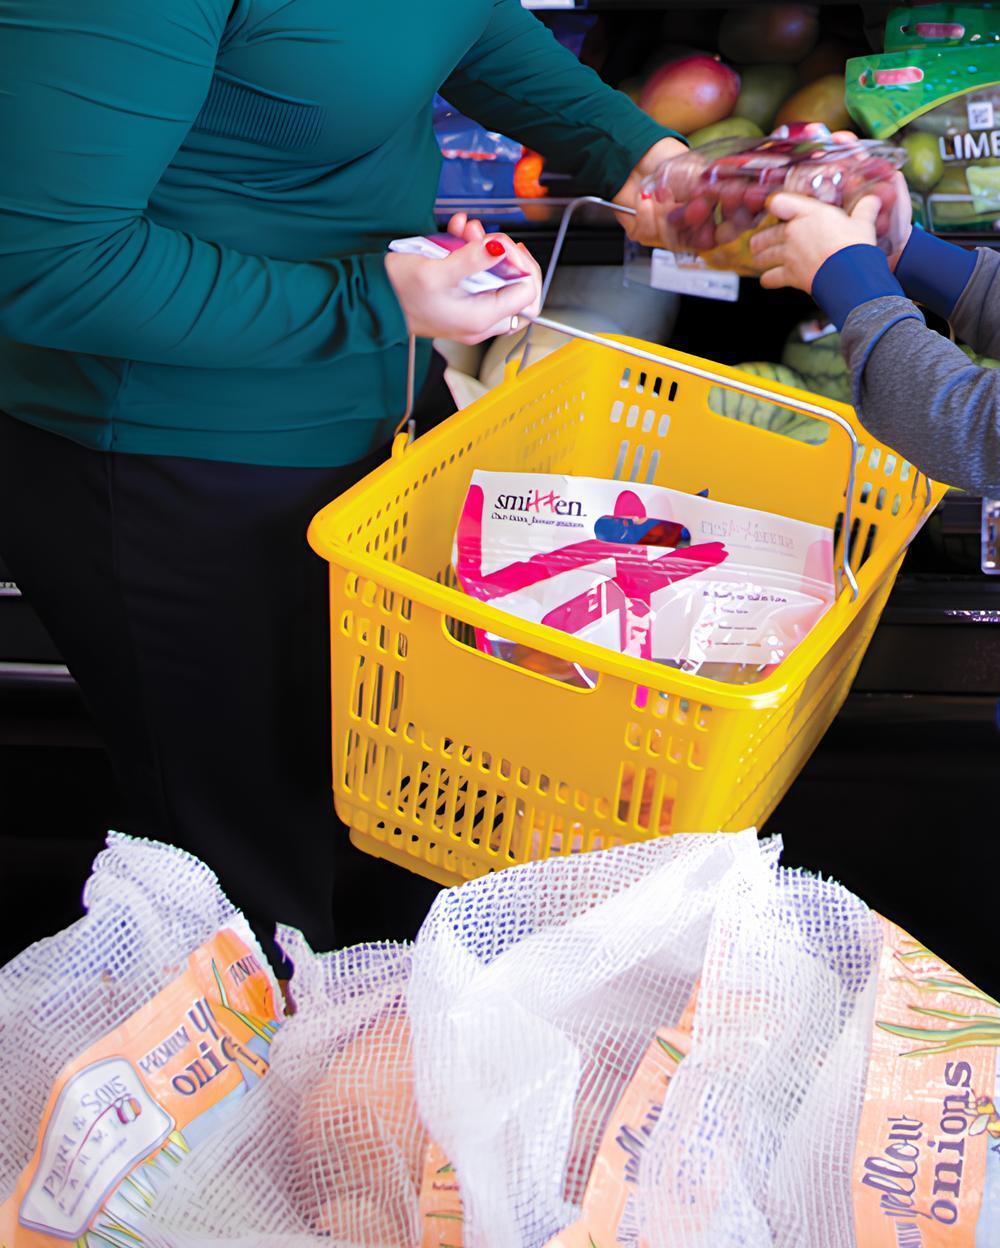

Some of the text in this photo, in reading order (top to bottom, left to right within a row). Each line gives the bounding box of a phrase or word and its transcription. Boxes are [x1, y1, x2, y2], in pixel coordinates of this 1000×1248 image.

[494, 488, 583, 517] smitten
[861, 1114, 933, 1221] yellow
[926, 1060, 972, 1225] onions
